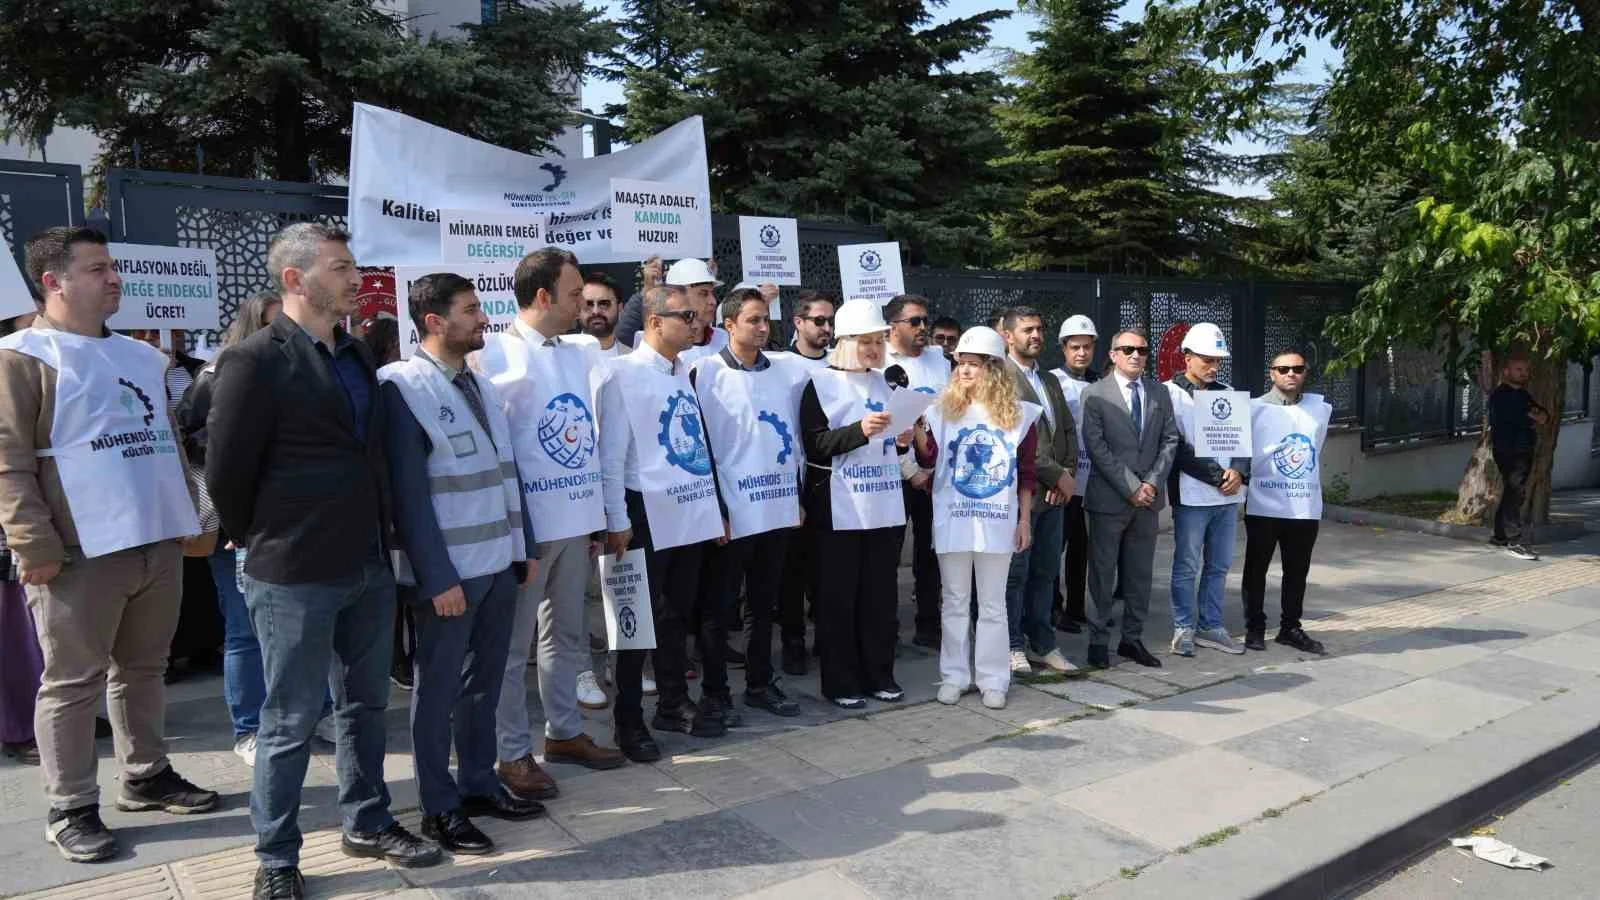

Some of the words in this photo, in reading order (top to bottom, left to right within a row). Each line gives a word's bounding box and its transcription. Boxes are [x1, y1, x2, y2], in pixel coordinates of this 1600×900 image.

[615, 191, 657, 208] MAAŞTA
[660, 195, 698, 210] ADALET,
[634, 210, 681, 225] KAMUDA
[449, 220, 502, 237] MİMARIN
[506, 223, 539, 239] EMEĞİ
[545, 229, 591, 245] değer
[638, 229, 678, 243] HUZUR!
[467, 241, 525, 259] DEĞERSİZ
[180, 259, 211, 278] DEĞİL,
[121, 280, 154, 297] MEĞE
[157, 280, 213, 299] ENDEKSLİ
[477, 272, 514, 292] ÖZLÜK
[146, 302, 185, 319] ÜCRET!
[90, 428, 156, 452] MÜHENDİS
[121, 445, 155, 459] KÜLTÜR
[737, 472, 781, 492] MÜHENDİS
